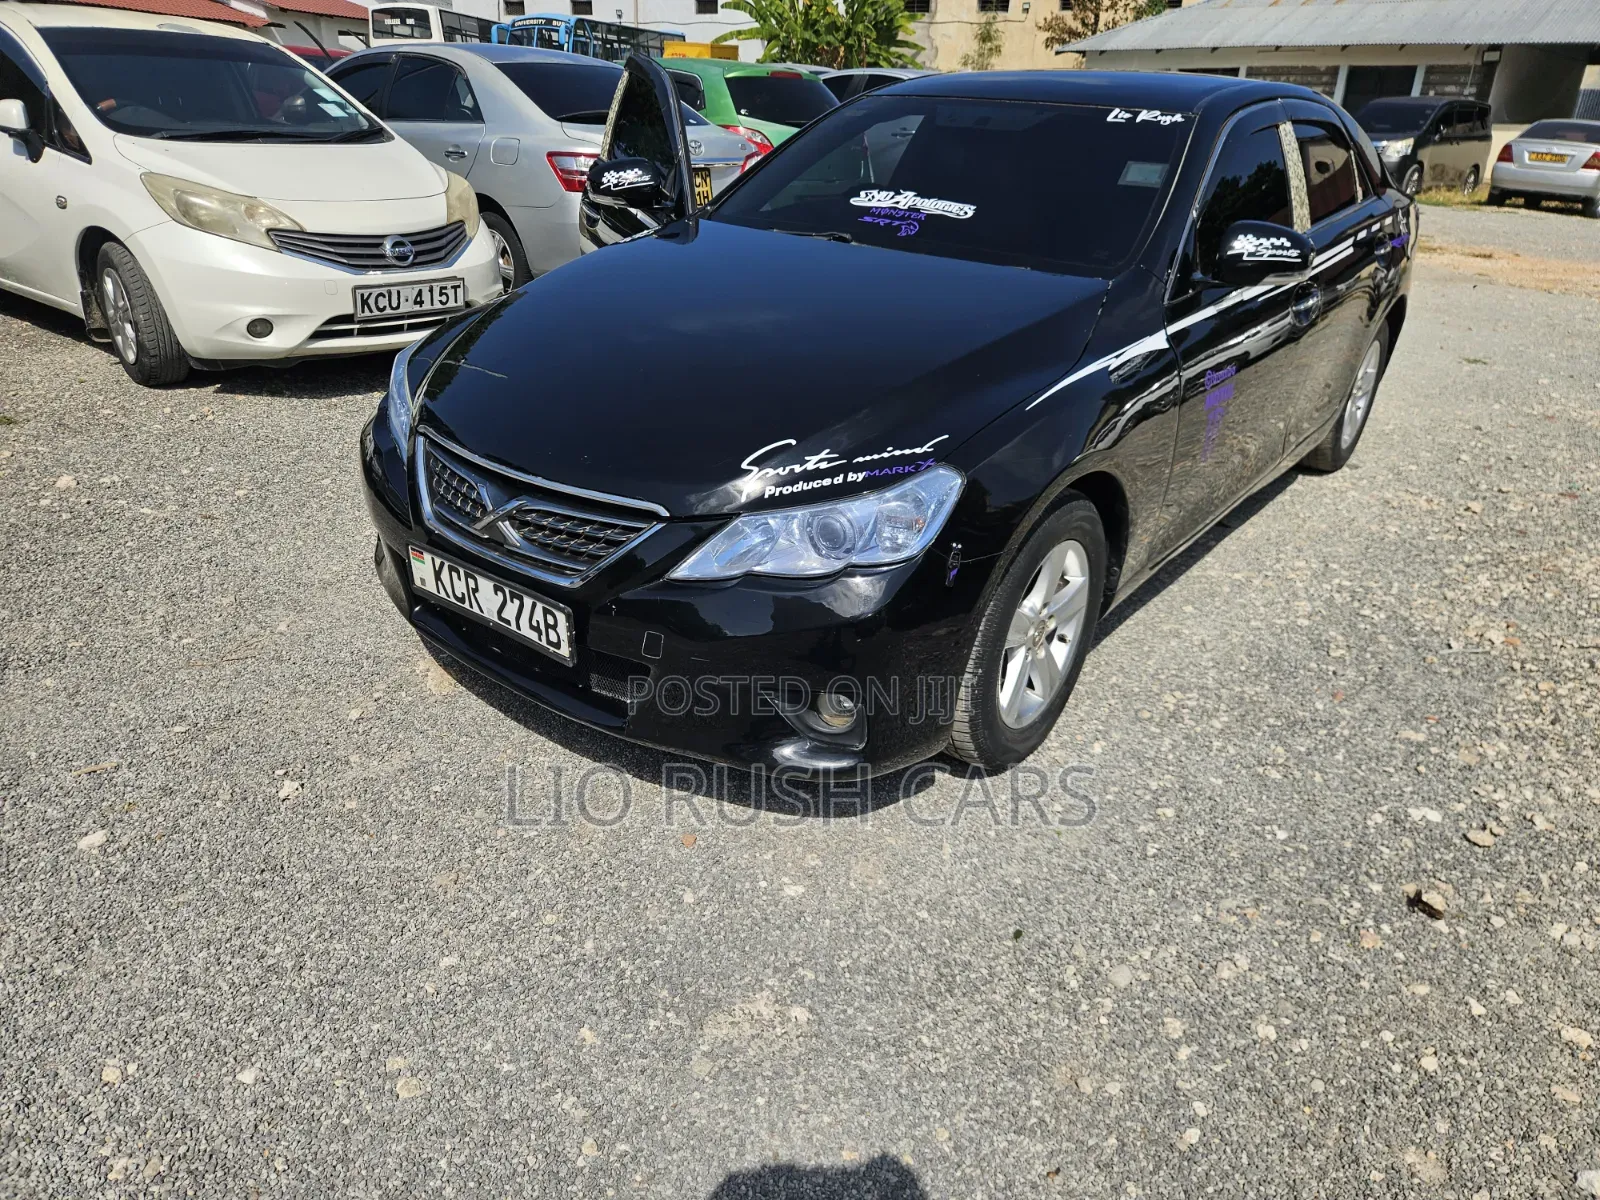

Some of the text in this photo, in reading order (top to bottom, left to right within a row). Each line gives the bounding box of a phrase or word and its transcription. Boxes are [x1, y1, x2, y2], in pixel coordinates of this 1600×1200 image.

[514, 19, 547, 27] UNIVERSITY
[693, 171, 709, 189] CN
[359, 283, 461, 315] KCU 415T
[763, 472, 845, 499] Produced
[846, 470, 867, 483] by
[430, 556, 562, 651] KCR 274B
